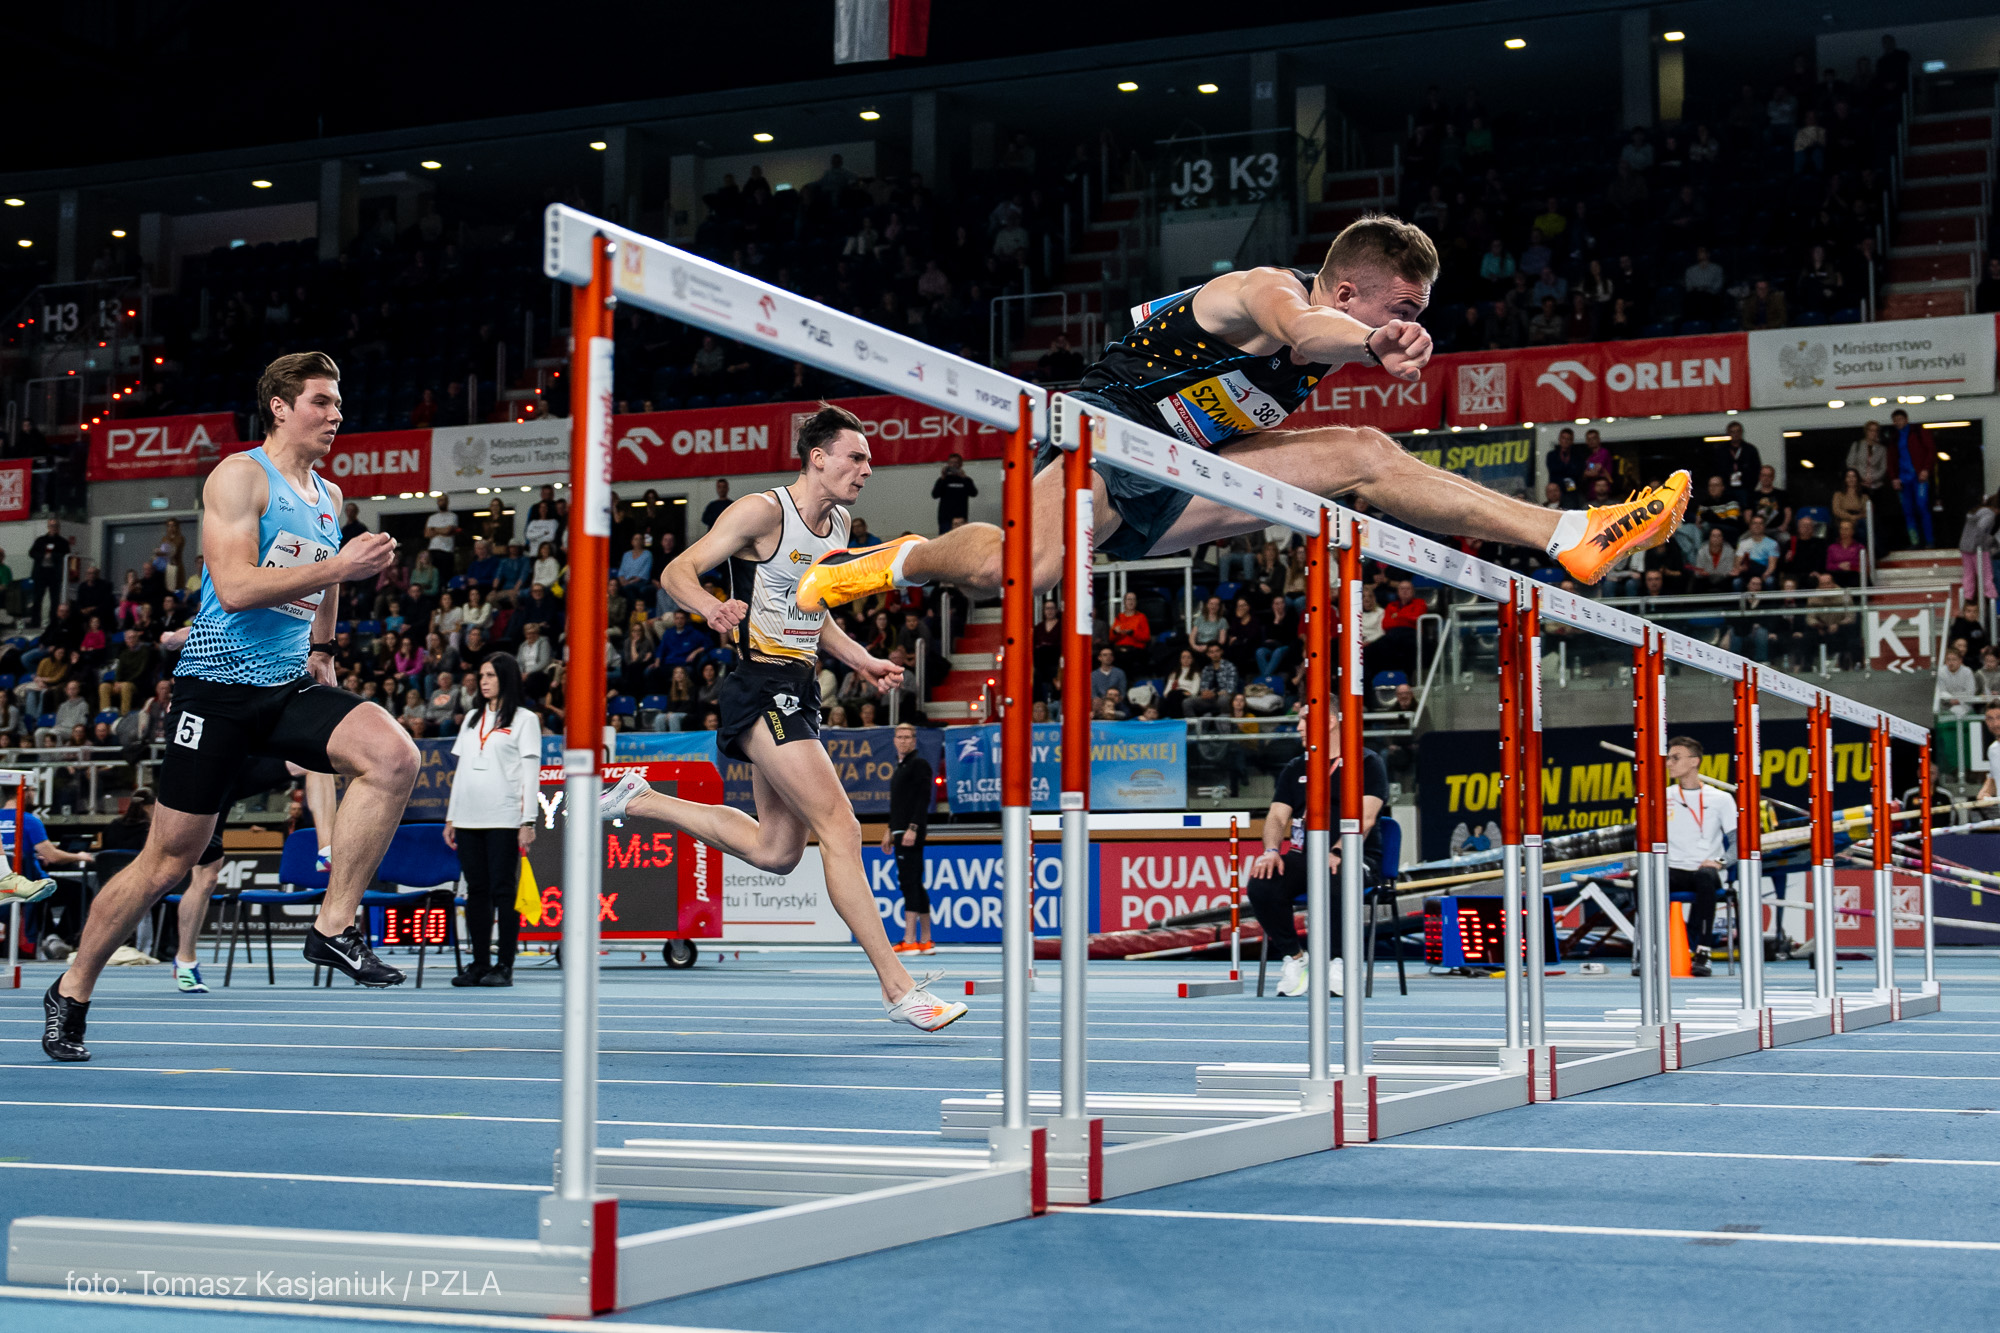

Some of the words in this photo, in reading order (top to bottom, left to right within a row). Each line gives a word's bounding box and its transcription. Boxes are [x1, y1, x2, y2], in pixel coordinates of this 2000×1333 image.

[1170, 159, 1214, 195] J3
[1229, 153, 1279, 188] K3
[43, 302, 79, 333] H3
[1833, 339, 1932, 356] Ministerstwo
[1605, 356, 1731, 392] ORLEN
[1833, 359, 1883, 376] Sportu
[1887, 357, 1892, 370] i
[1896, 353, 1966, 372] Turystyki
[1253, 402, 1280, 427] 382
[1462, 395, 1503, 413] PZLA
[107, 424, 213, 459] PZLA
[490, 436, 559, 449] Ministerstwo
[671, 425, 769, 456] ORLEN
[331, 449, 420, 477] ORLEN
[490, 453, 523, 466] Sportu
[1446, 440, 1530, 470] SPORTU
[1586, 499, 1664, 554] NITRO
[1868, 609, 1931, 658] K1
[180, 715, 195, 744] 5
[827, 740, 872, 758] PZLA
[957, 780, 972, 793] 21
[957, 792, 1000, 804] STADION
[607, 833, 674, 868] M:5
[694, 839, 710, 902] polanik
[753, 893, 817, 909] Turystyki
